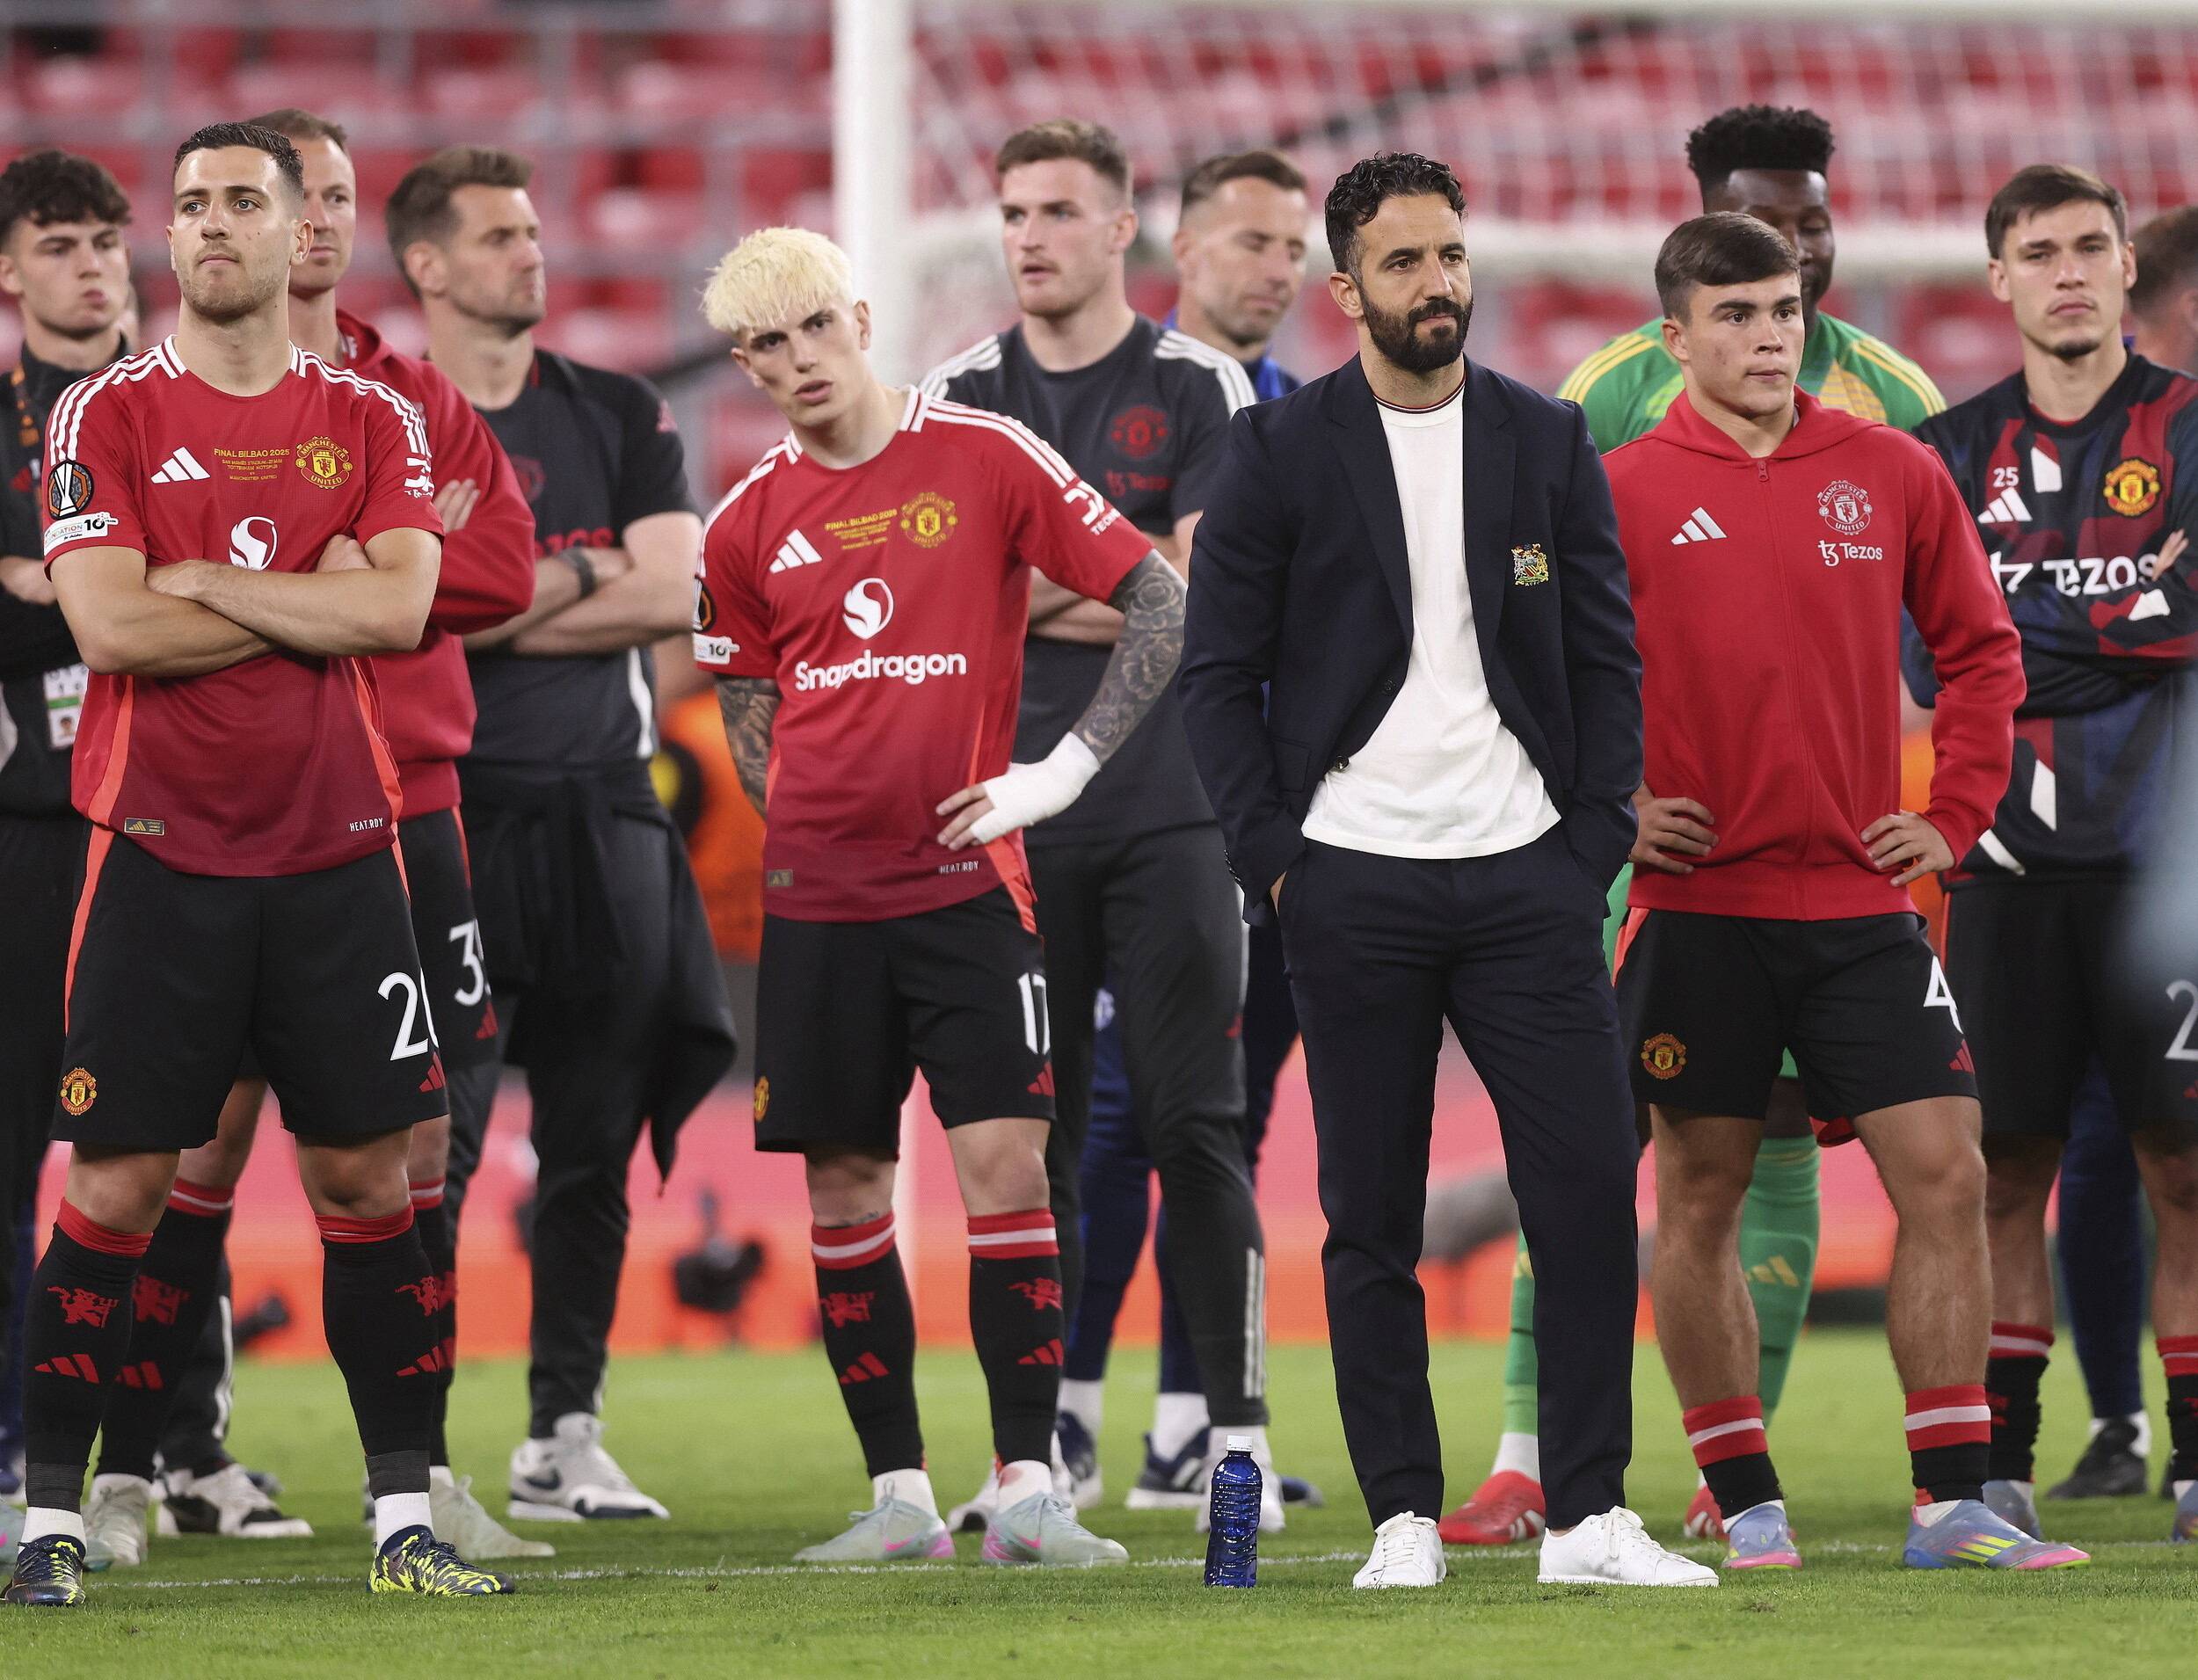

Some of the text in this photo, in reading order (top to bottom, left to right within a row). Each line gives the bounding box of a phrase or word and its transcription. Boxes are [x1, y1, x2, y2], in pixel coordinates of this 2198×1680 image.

[214, 447, 237, 457] FINAL
[238, 449, 268, 458] BILBAO
[301, 440, 346, 459] MANCHESTER
[310, 475, 342, 485] UNITED
[1993, 466, 2020, 487] 25
[1822, 484, 1865, 503] MANCHESTER
[84, 519, 106, 531] 10
[1835, 520, 1865, 531] UNITED
[1839, 542, 1883, 561] Tezos
[709, 643, 726, 657] 10
[795, 649, 967, 691] Snapdragon
[349, 817, 383, 833] HEAT.RDY
[377, 968, 440, 1061] 2
